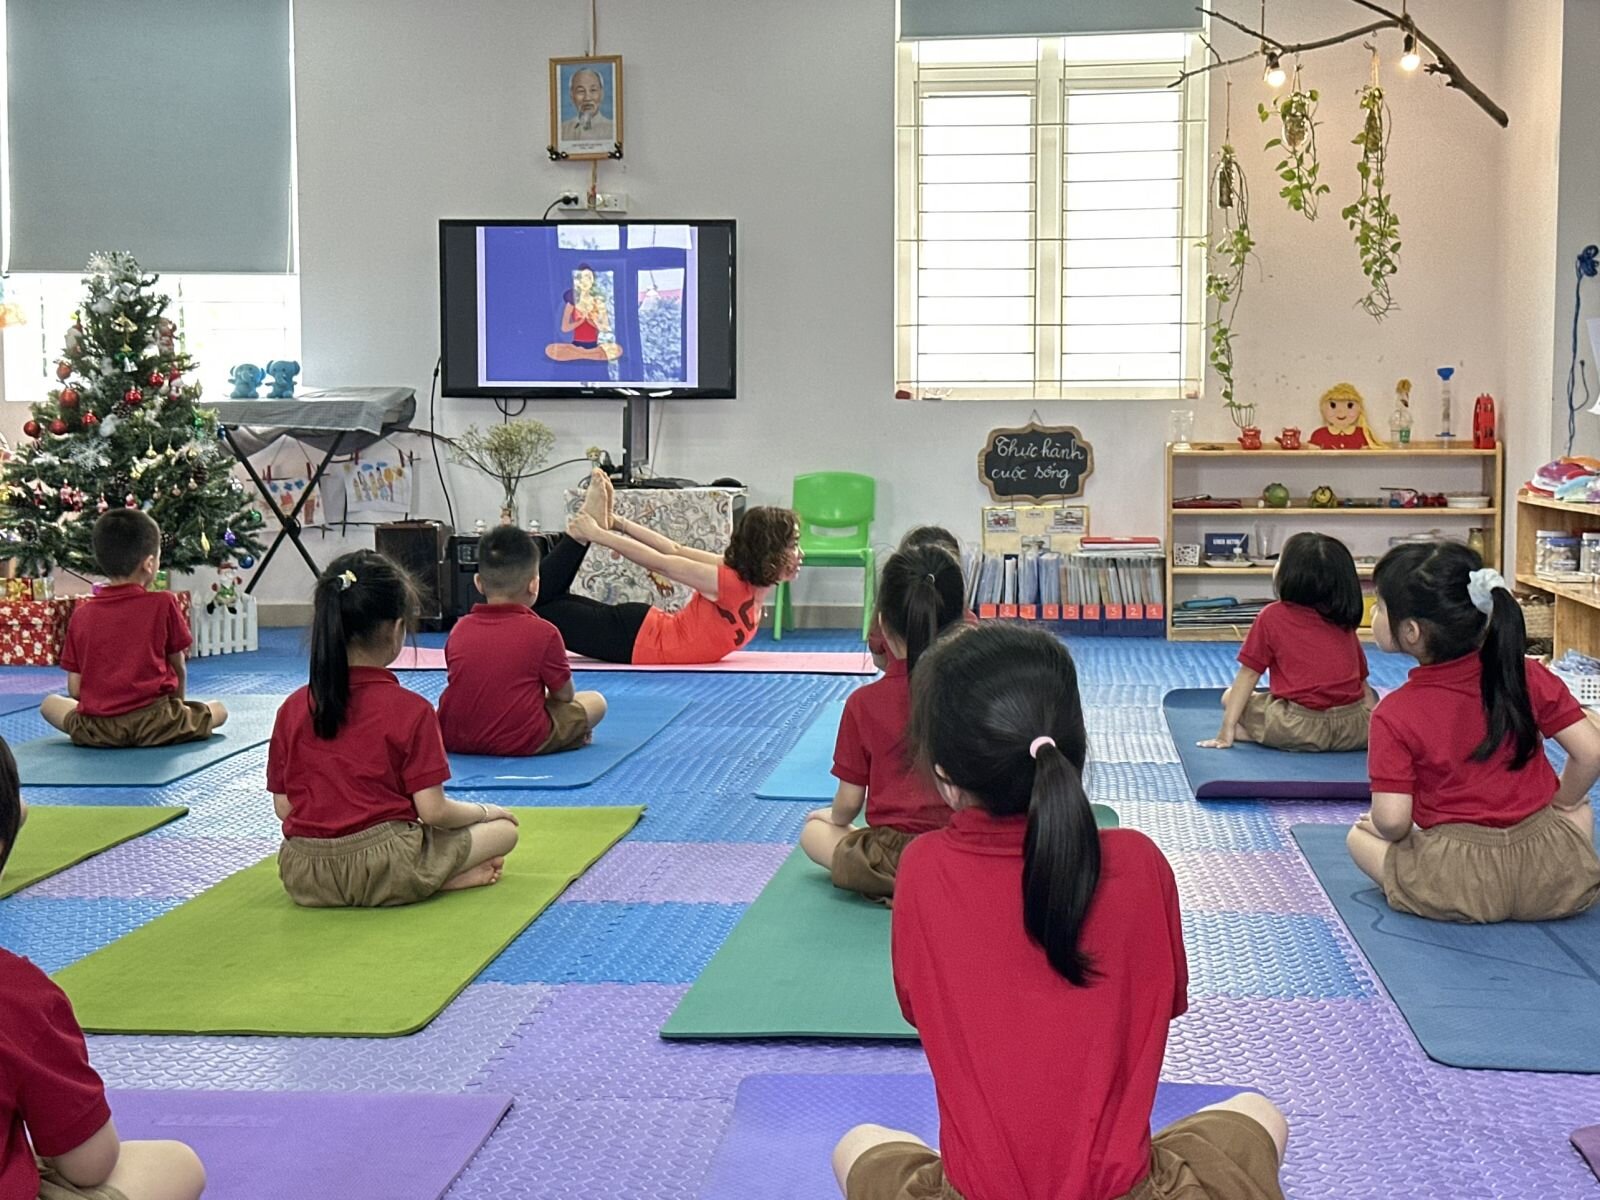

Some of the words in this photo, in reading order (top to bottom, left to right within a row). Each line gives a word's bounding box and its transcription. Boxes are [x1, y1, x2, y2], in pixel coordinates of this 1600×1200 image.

[996, 436, 1038, 459] Thực
[1041, 438, 1084, 460] hành
[991, 466, 1027, 481] cuộc
[1034, 462, 1071, 489] sống
[1068, 606, 1075, 617] 5
[1130, 607, 1139, 616] 2
[1151, 607, 1158, 616] 1
